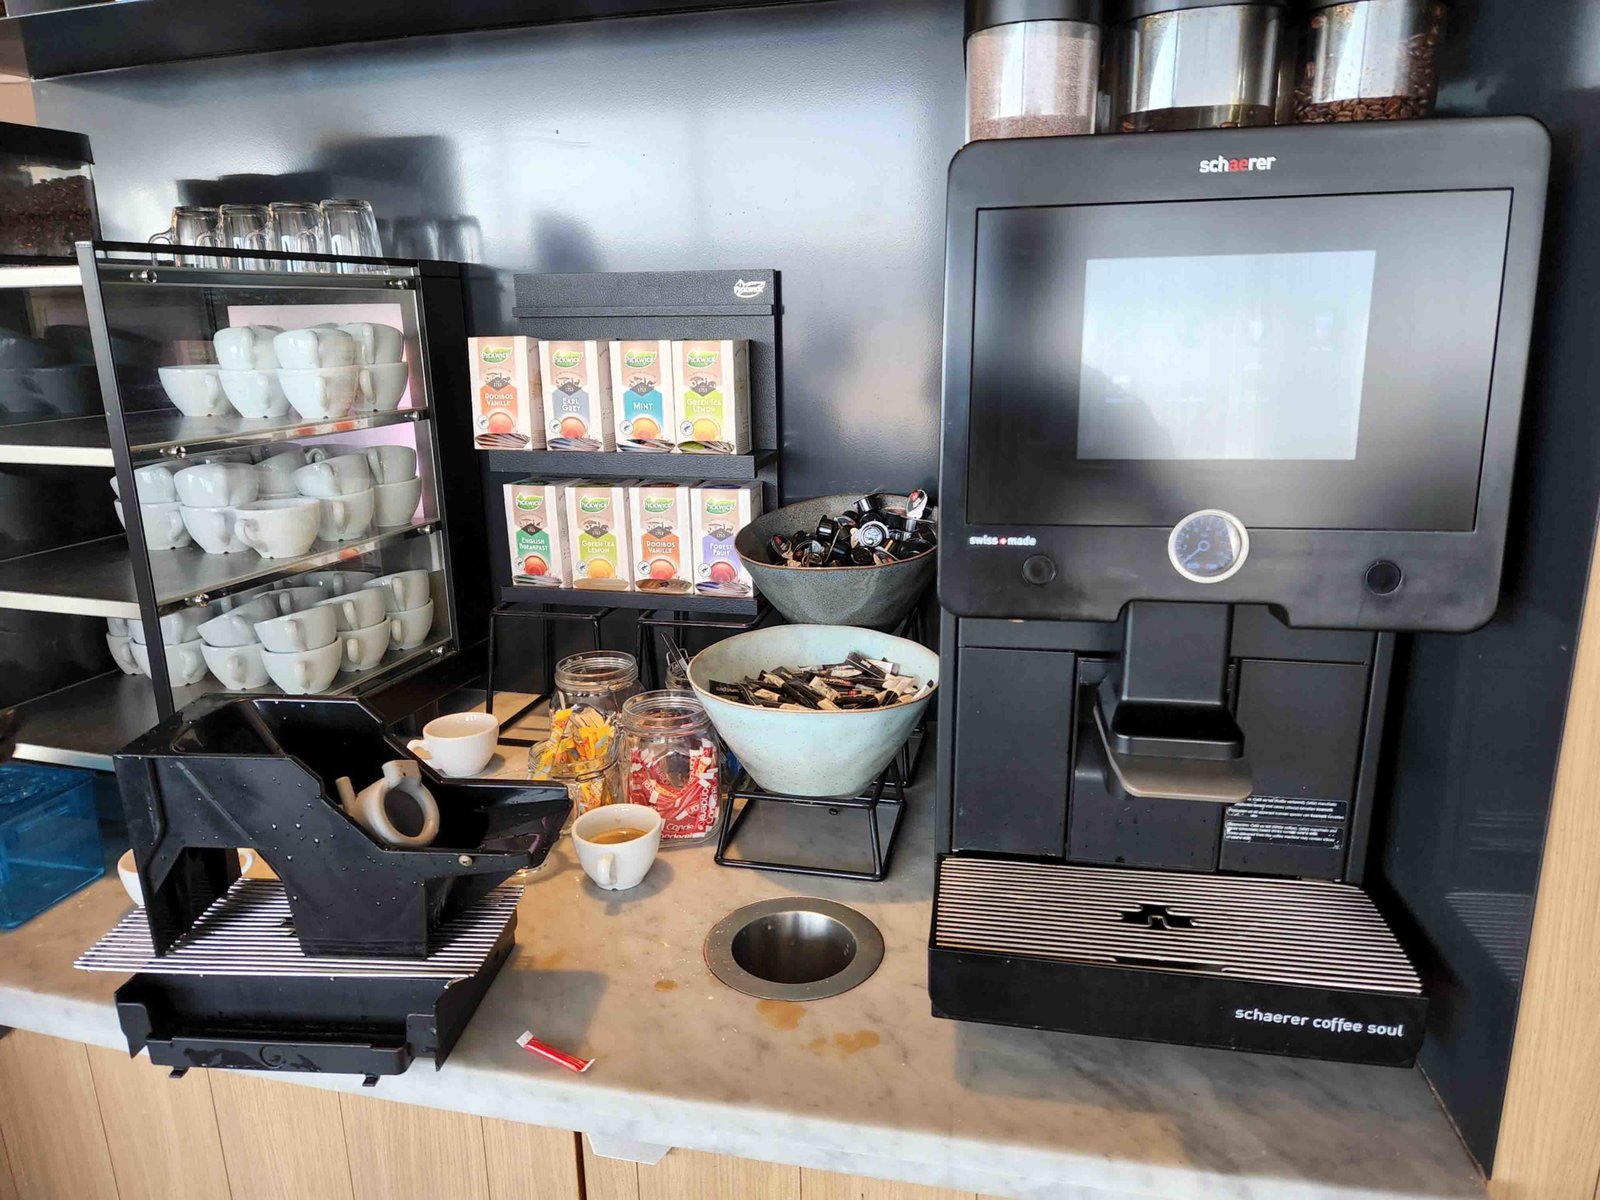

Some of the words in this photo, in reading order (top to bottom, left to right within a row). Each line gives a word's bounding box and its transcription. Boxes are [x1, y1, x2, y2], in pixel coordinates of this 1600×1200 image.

[1199, 154, 1277, 173] schaerer
[481, 351, 511, 360] PICKWICK
[552, 356, 582, 364] PICKWICK
[624, 356, 655, 364] PICKWICK
[562, 397, 580, 405] EARL
[561, 404, 581, 412] GREY
[632, 401, 654, 411] MINT
[515, 499, 542, 507] PICKWICK
[580, 501, 608, 509] PICKWICK
[645, 501, 672, 509] PICKWICK
[704, 502, 735, 510] PICKWICK
[646, 540, 676, 548] ROOIBOS
[969, 534, 999, 546] swiss
[1007, 535, 1037, 547] made
[519, 542, 549, 551] BREAKFAST
[709, 542, 734, 550] FOREST
[1234, 1008, 1309, 1027] schaerer
[1312, 1017, 1363, 1033] coffee
[1367, 1024, 1404, 1037] soul
